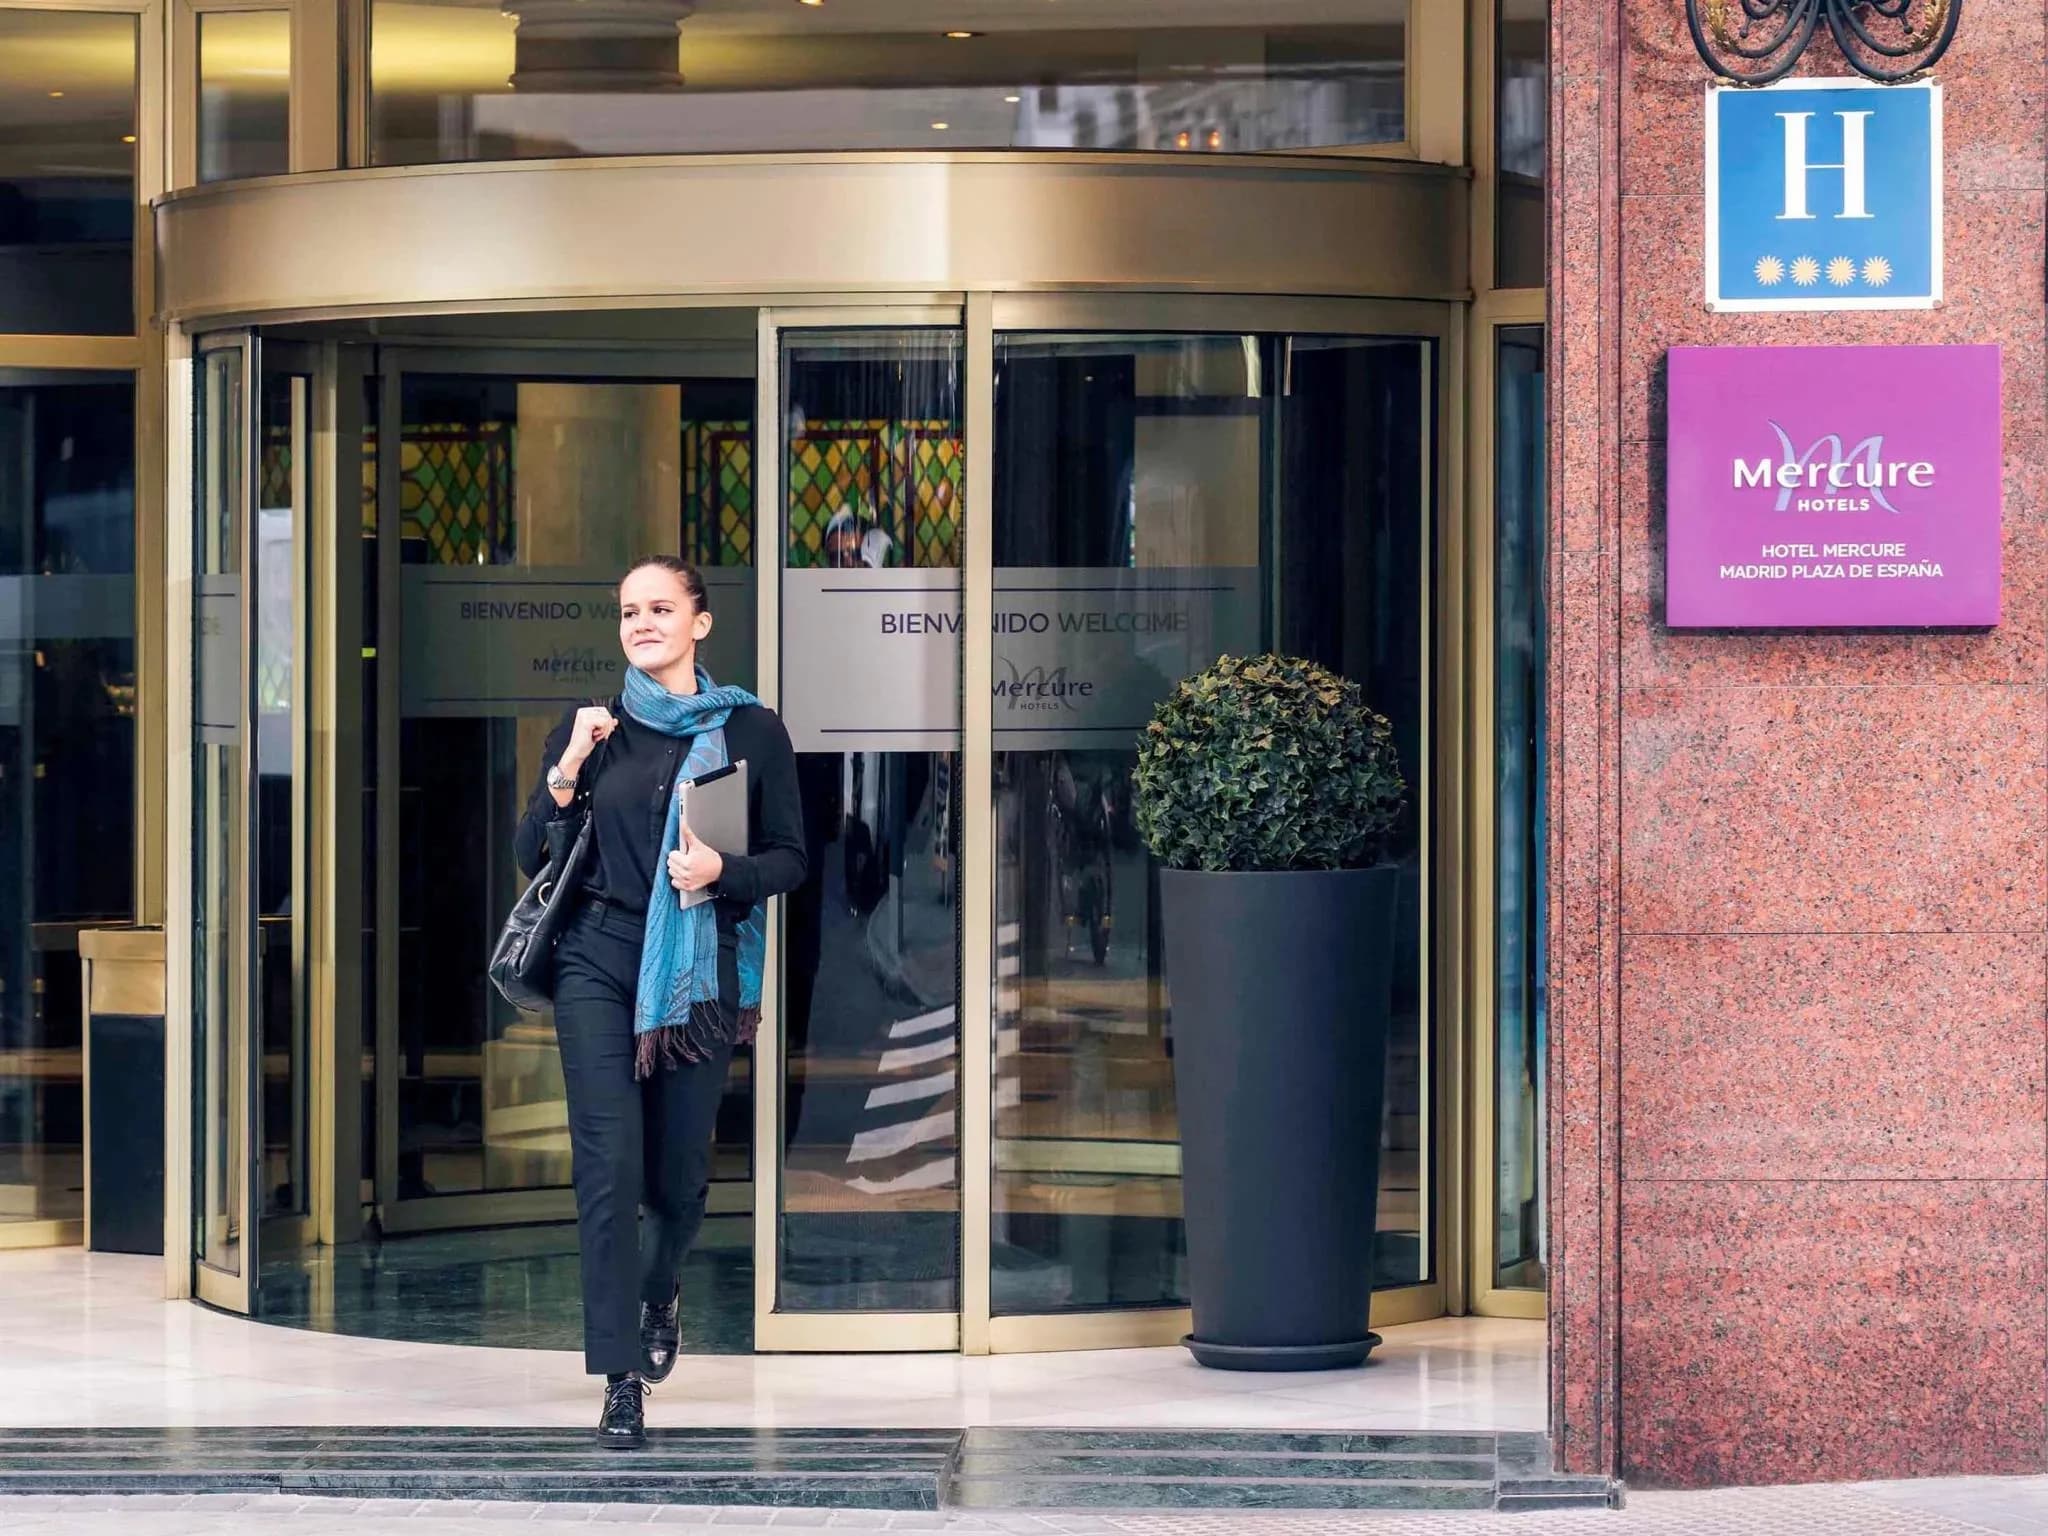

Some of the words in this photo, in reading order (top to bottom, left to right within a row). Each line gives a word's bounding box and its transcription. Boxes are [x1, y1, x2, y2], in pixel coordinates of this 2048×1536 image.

[1775, 111, 1875, 219] H
[1733, 458, 1936, 489] Mercure
[1797, 499, 1870, 512] HOTELS
[1762, 544, 1818, 559] HOTEL
[1823, 543, 1906, 558] MERCURE
[1720, 565, 1788, 579] MADRID
[1792, 564, 1846, 579] PLAZA
[1849, 564, 1873, 578] DE
[1877, 559, 1944, 577] ESPAÑA
[460, 602, 583, 620] BIENVENIDO
[880, 612, 1050, 634] BIENVIDO
[1057, 612, 1188, 632] WELCOME
[532, 657, 617, 672] Mercure
[1020, 702, 1060, 711] HOTELS
